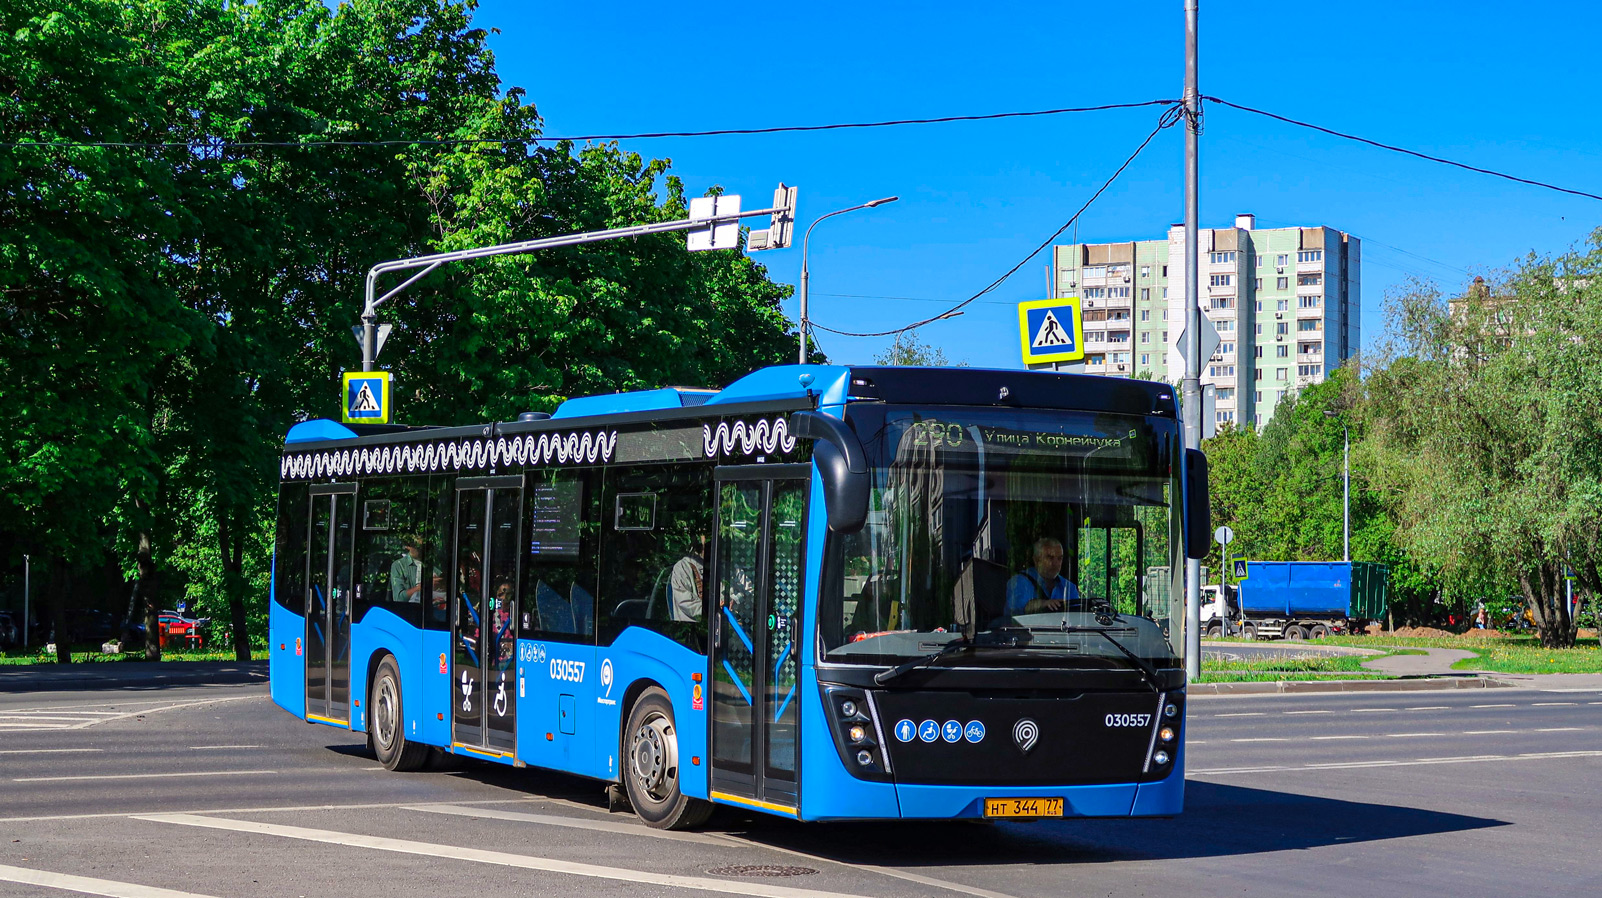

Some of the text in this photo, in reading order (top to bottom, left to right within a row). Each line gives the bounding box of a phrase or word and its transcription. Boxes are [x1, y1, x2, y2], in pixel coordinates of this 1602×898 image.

[984, 429, 1029, 447] Улица
[1036, 431, 1121, 450] Корнейчука
[550, 658, 586, 683] 030557
[1105, 713, 1151, 728] 030557
[1013, 800, 1038, 815] 344
[1046, 799, 1059, 811] 77
